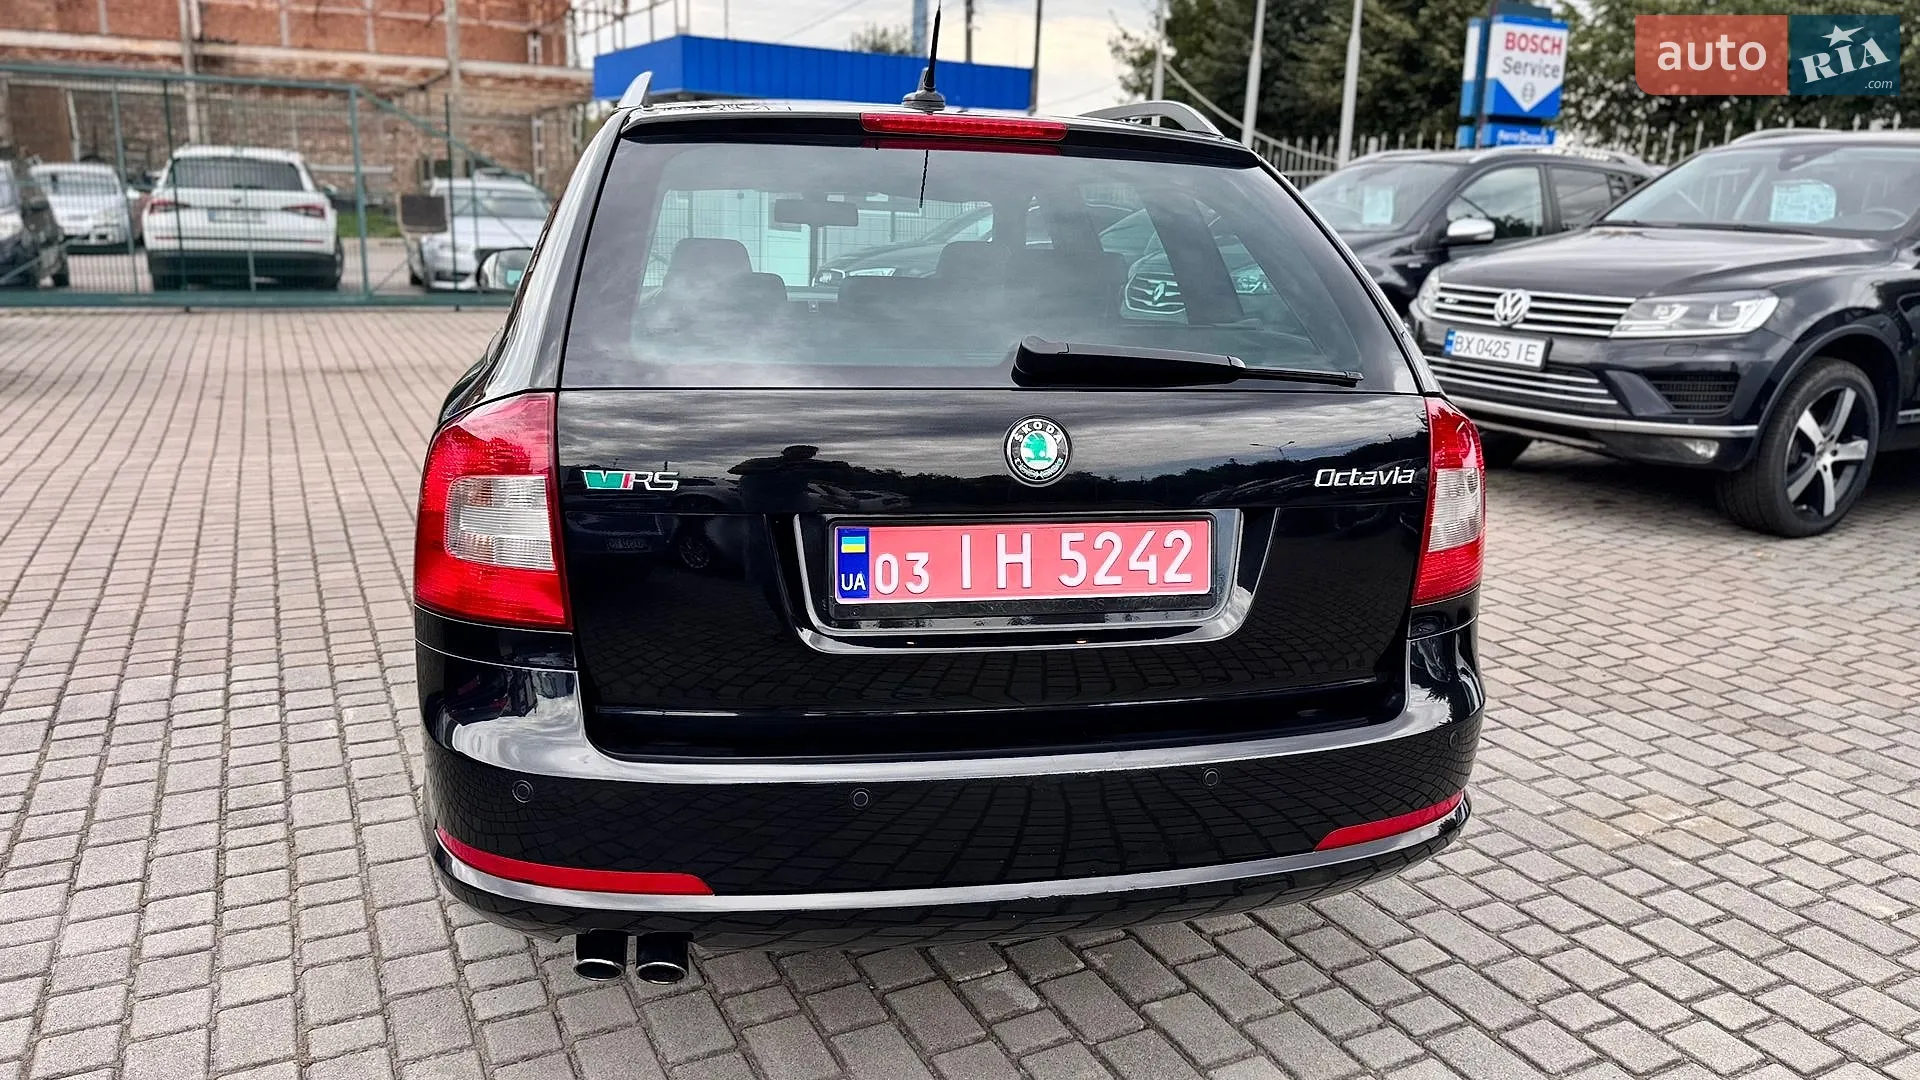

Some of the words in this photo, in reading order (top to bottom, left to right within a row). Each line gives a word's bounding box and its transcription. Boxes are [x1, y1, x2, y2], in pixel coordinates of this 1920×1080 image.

[1505, 32, 1562, 54] BOSCH
[1502, 56, 1560, 79] Service
[1453, 335, 1475, 354] BX
[1476, 338, 1512, 359] 0425
[1516, 343, 1538, 362] IE
[1314, 466, 1415, 487] Octavia
[841, 572, 866, 591] UA
[874, 552, 931, 595] 03
[1057, 528, 1194, 588] 5242
